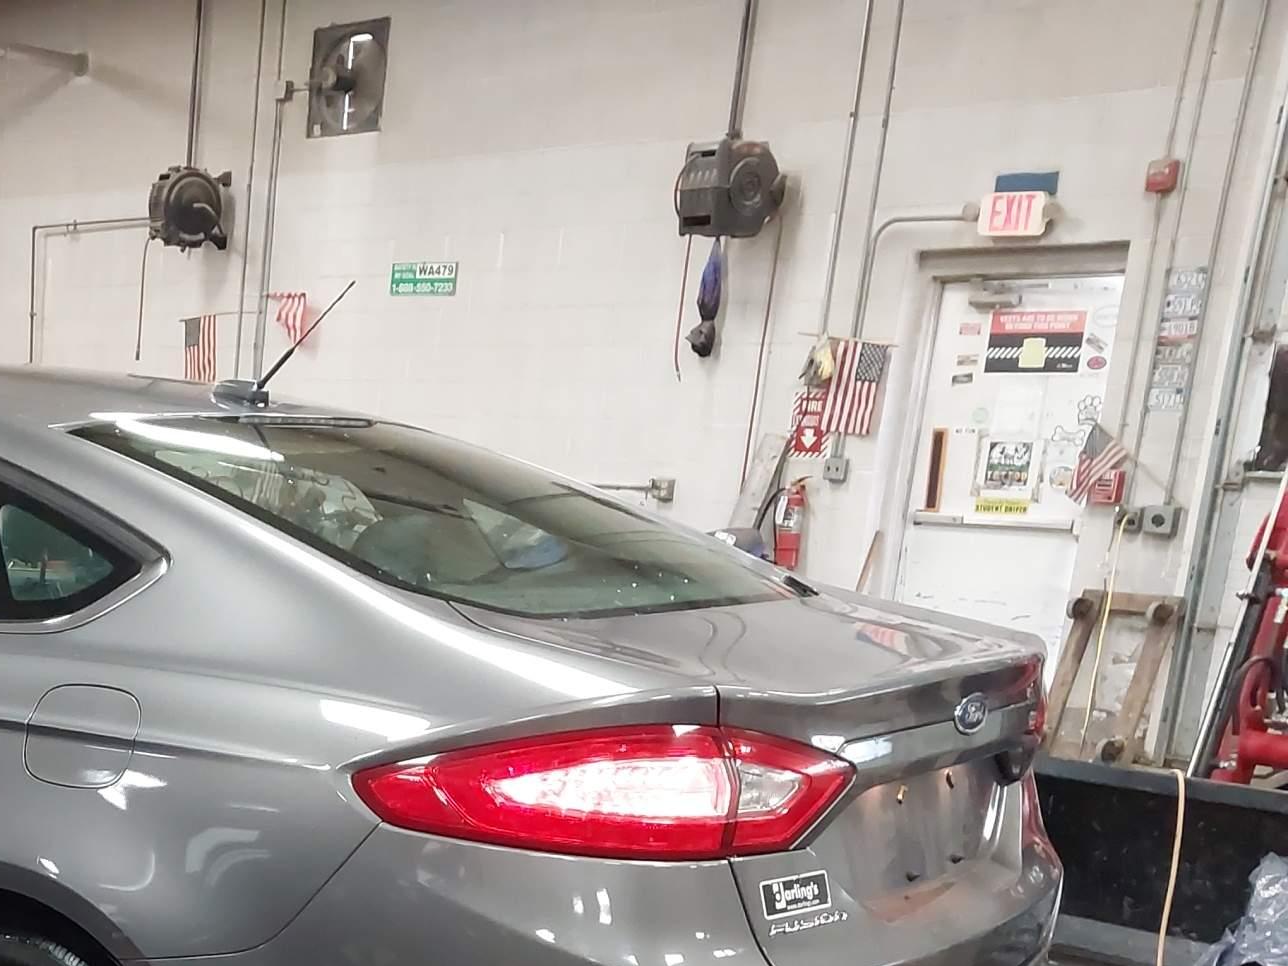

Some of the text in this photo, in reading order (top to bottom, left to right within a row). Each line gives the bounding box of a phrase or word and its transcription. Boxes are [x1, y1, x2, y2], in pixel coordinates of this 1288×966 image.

[988, 194, 1037, 233] EXIT
[418, 264, 454, 276] WA479
[801, 399, 823, 412] FIRE
